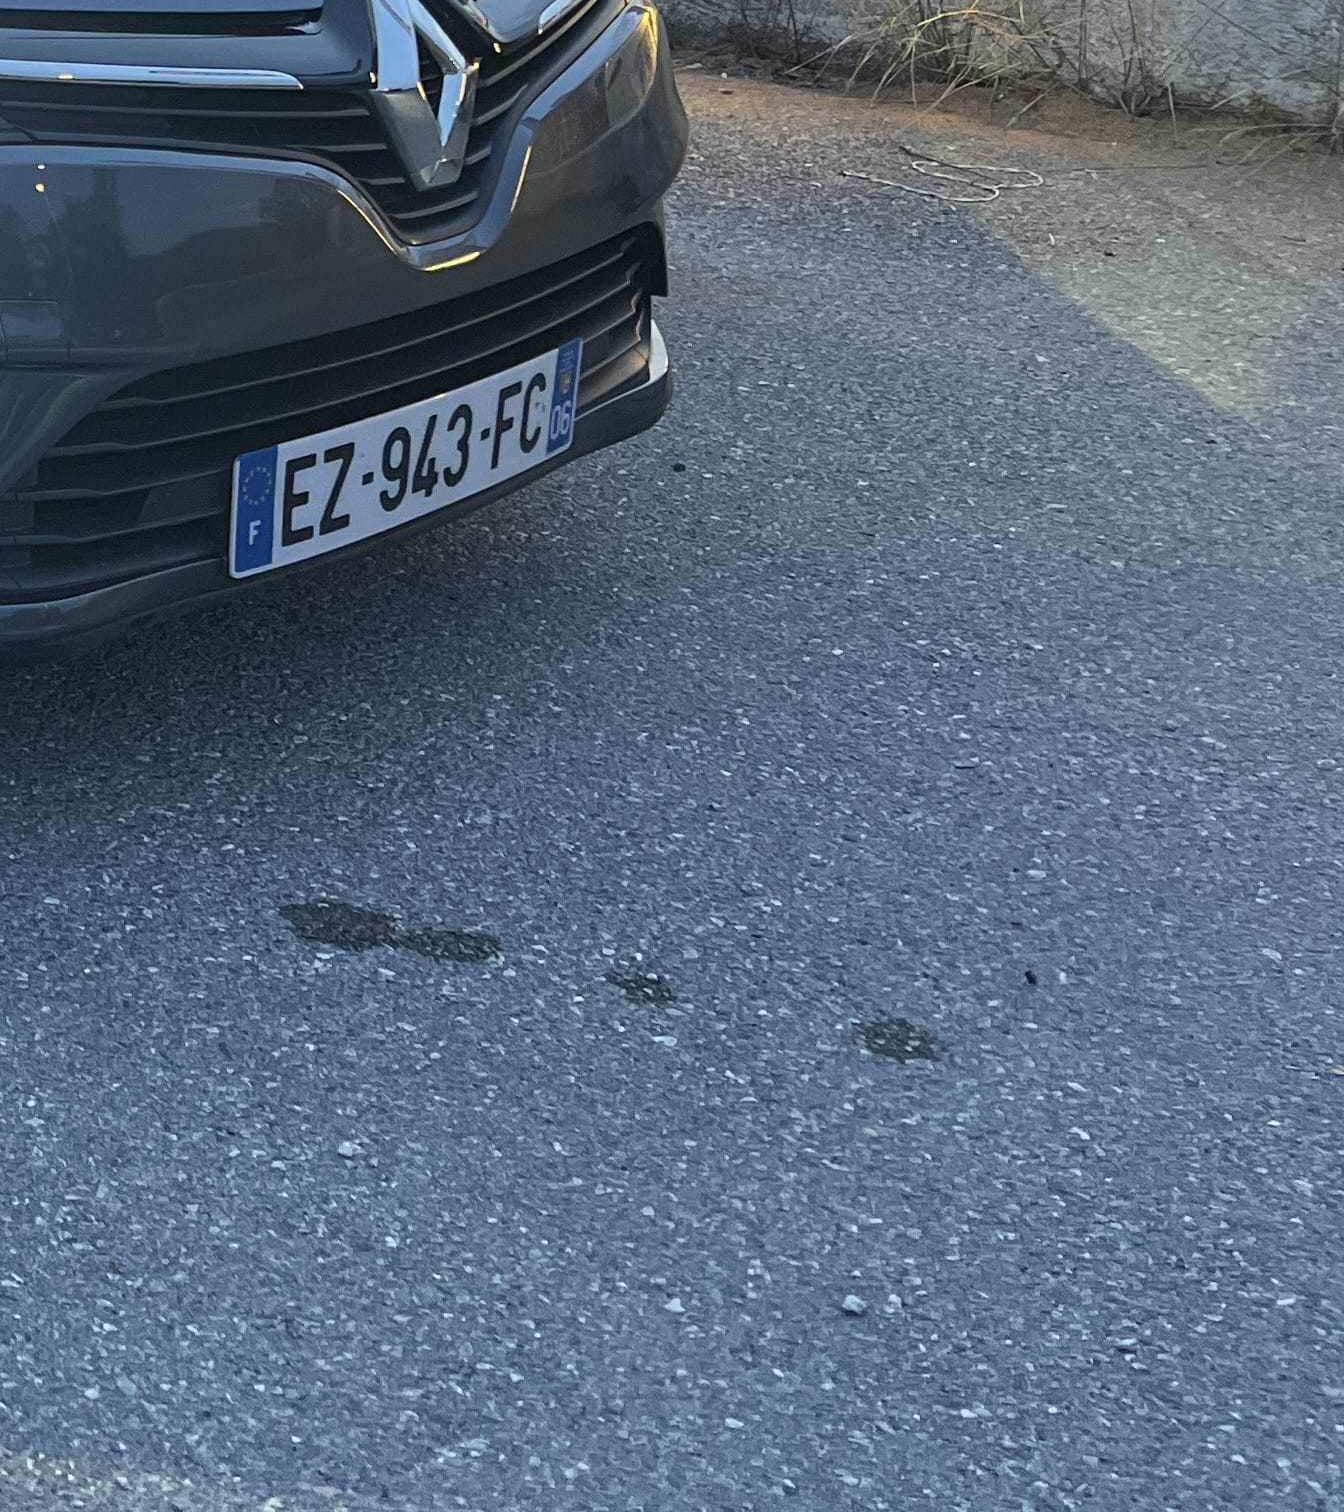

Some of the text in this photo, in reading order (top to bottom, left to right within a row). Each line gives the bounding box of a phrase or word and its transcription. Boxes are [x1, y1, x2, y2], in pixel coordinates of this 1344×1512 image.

[549, 400, 573, 442] 06
[281, 372, 547, 547] EZ-943-FC
[248, 519, 263, 546] F
